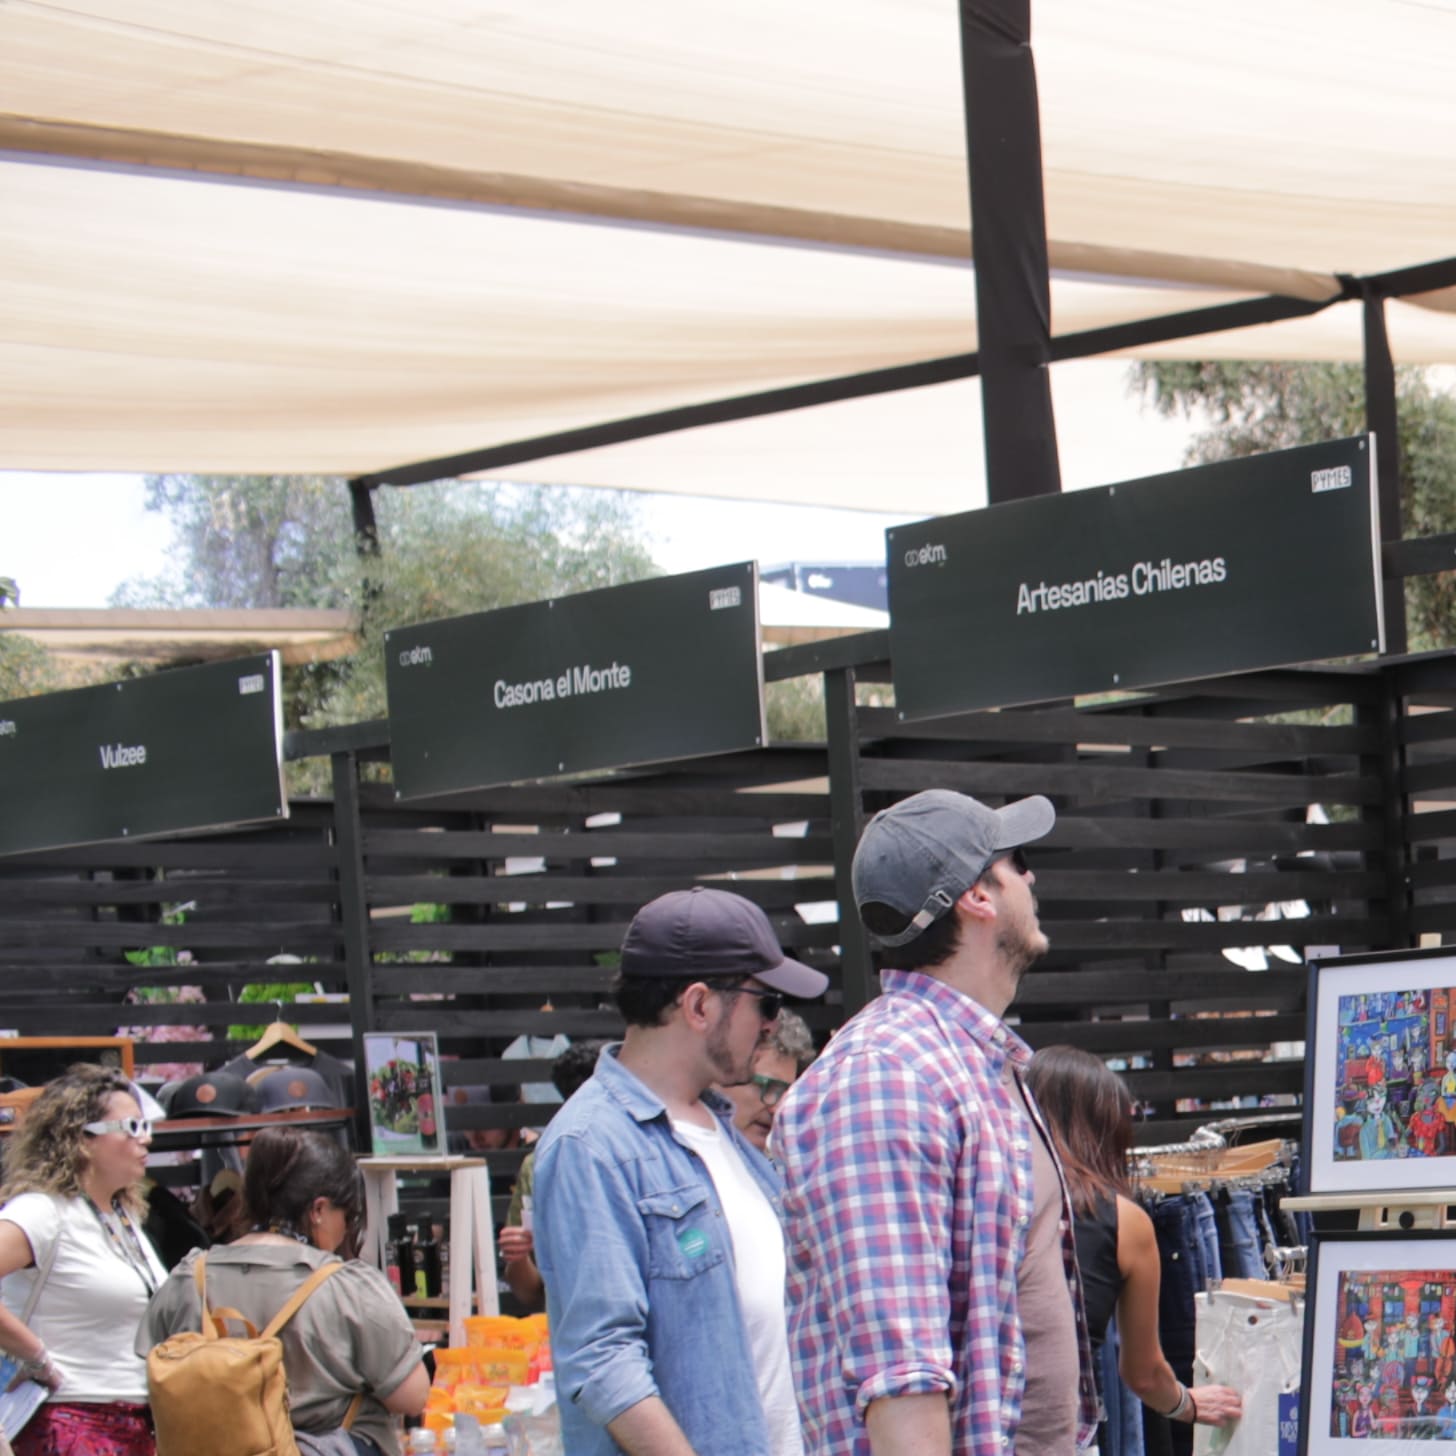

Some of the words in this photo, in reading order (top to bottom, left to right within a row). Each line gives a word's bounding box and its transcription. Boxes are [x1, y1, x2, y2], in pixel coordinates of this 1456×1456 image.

[1016, 570, 1129, 615] Artesanias
[1131, 556, 1227, 596] Chilenas
[494, 680, 554, 709] Casona
[556, 675, 572, 698] el
[573, 661, 631, 695] Monte
[100, 744, 147, 769] Vulzee
